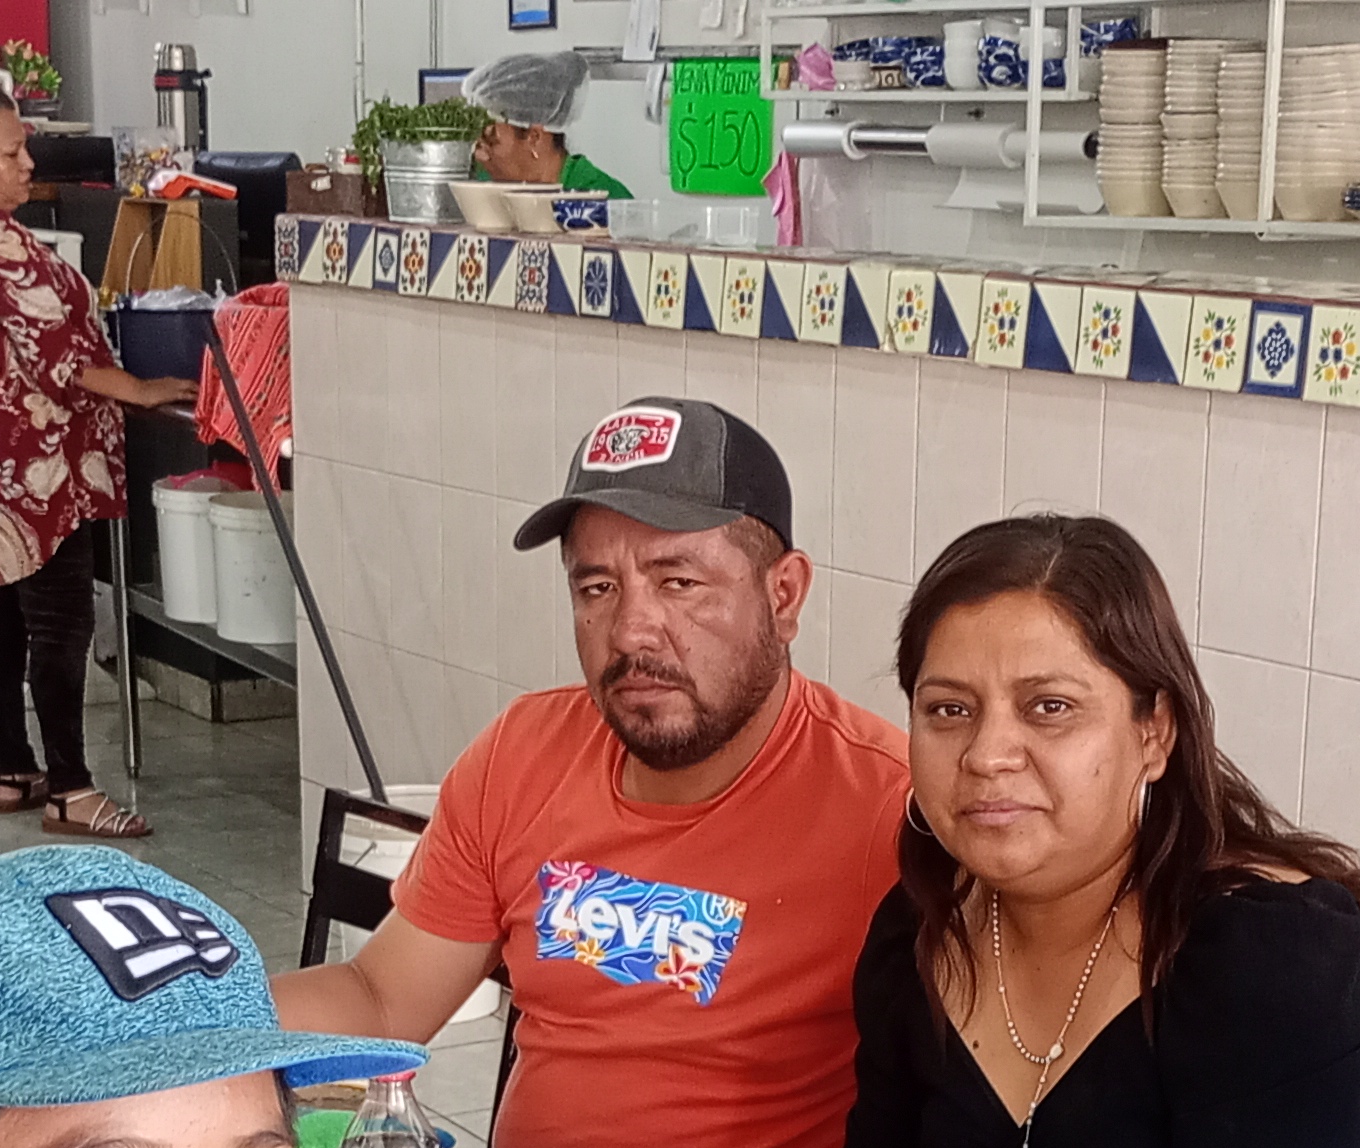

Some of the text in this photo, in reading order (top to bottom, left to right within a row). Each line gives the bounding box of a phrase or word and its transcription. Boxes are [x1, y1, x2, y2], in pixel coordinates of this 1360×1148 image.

[676, 102, 761, 188] $150
[648, 426, 670, 445] 15
[549, 887, 716, 966] Levi's
